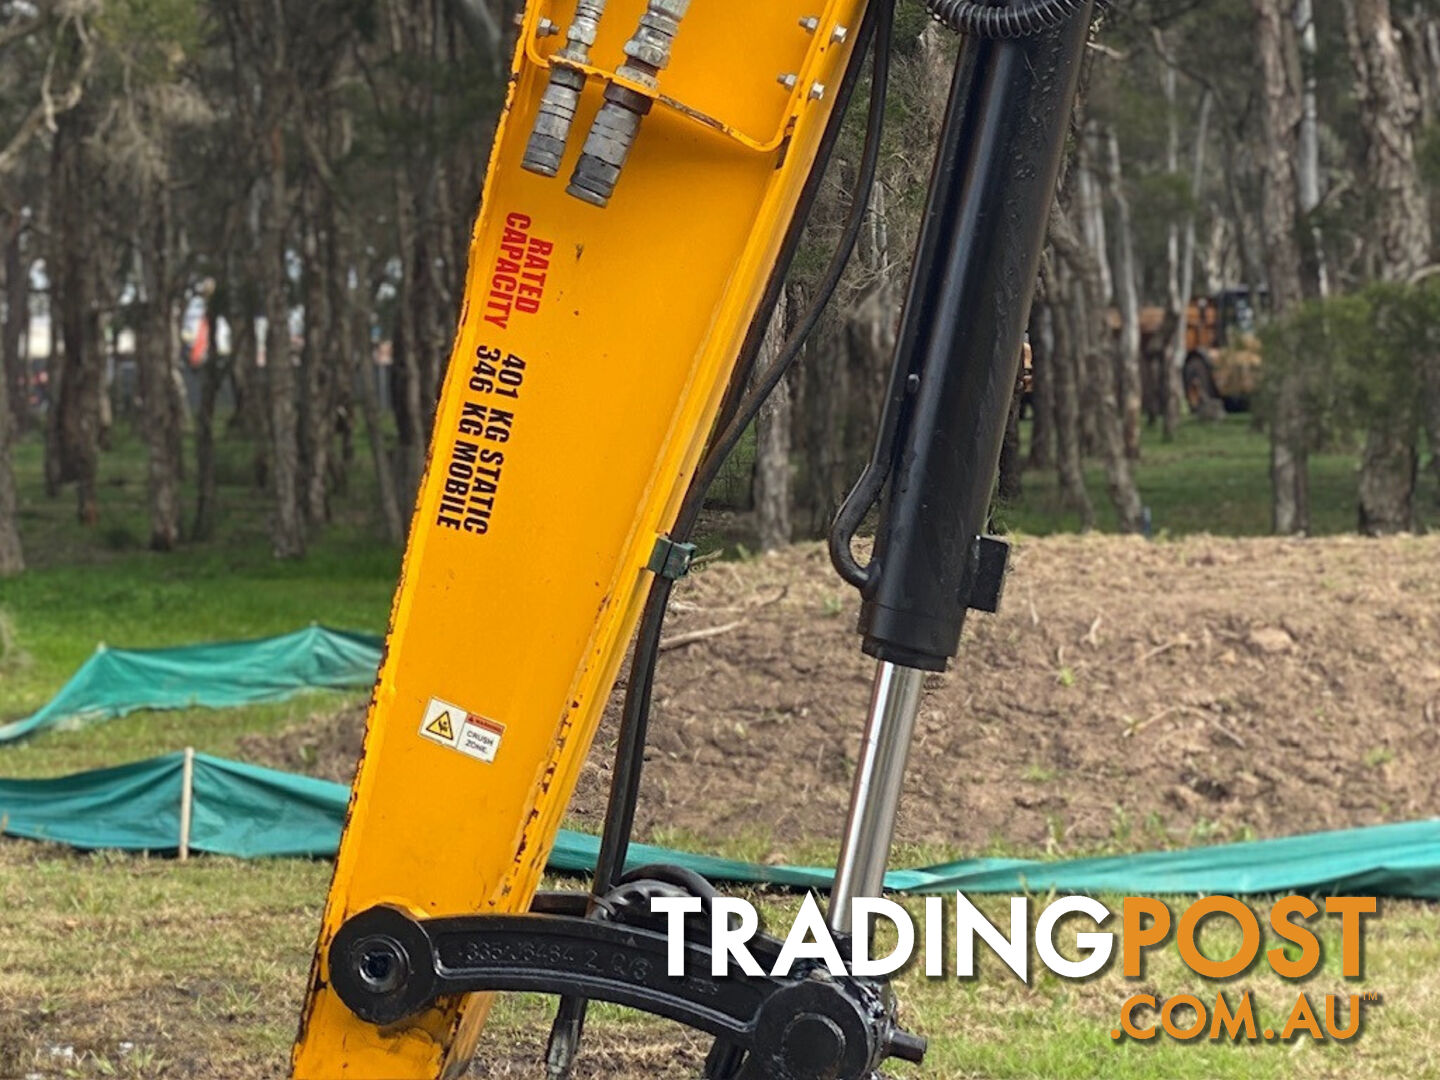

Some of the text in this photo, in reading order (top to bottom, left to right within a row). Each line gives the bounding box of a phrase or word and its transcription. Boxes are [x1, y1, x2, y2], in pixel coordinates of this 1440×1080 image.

[483, 211, 532, 330] CAPACITY
[514, 237, 554, 315] RATED
[436, 345, 501, 531] 346 KG MOBILE
[463, 353, 527, 536] 401 KG STATIC
[465, 739, 488, 754] ZONE
[466, 730, 494, 747] CRUSH
